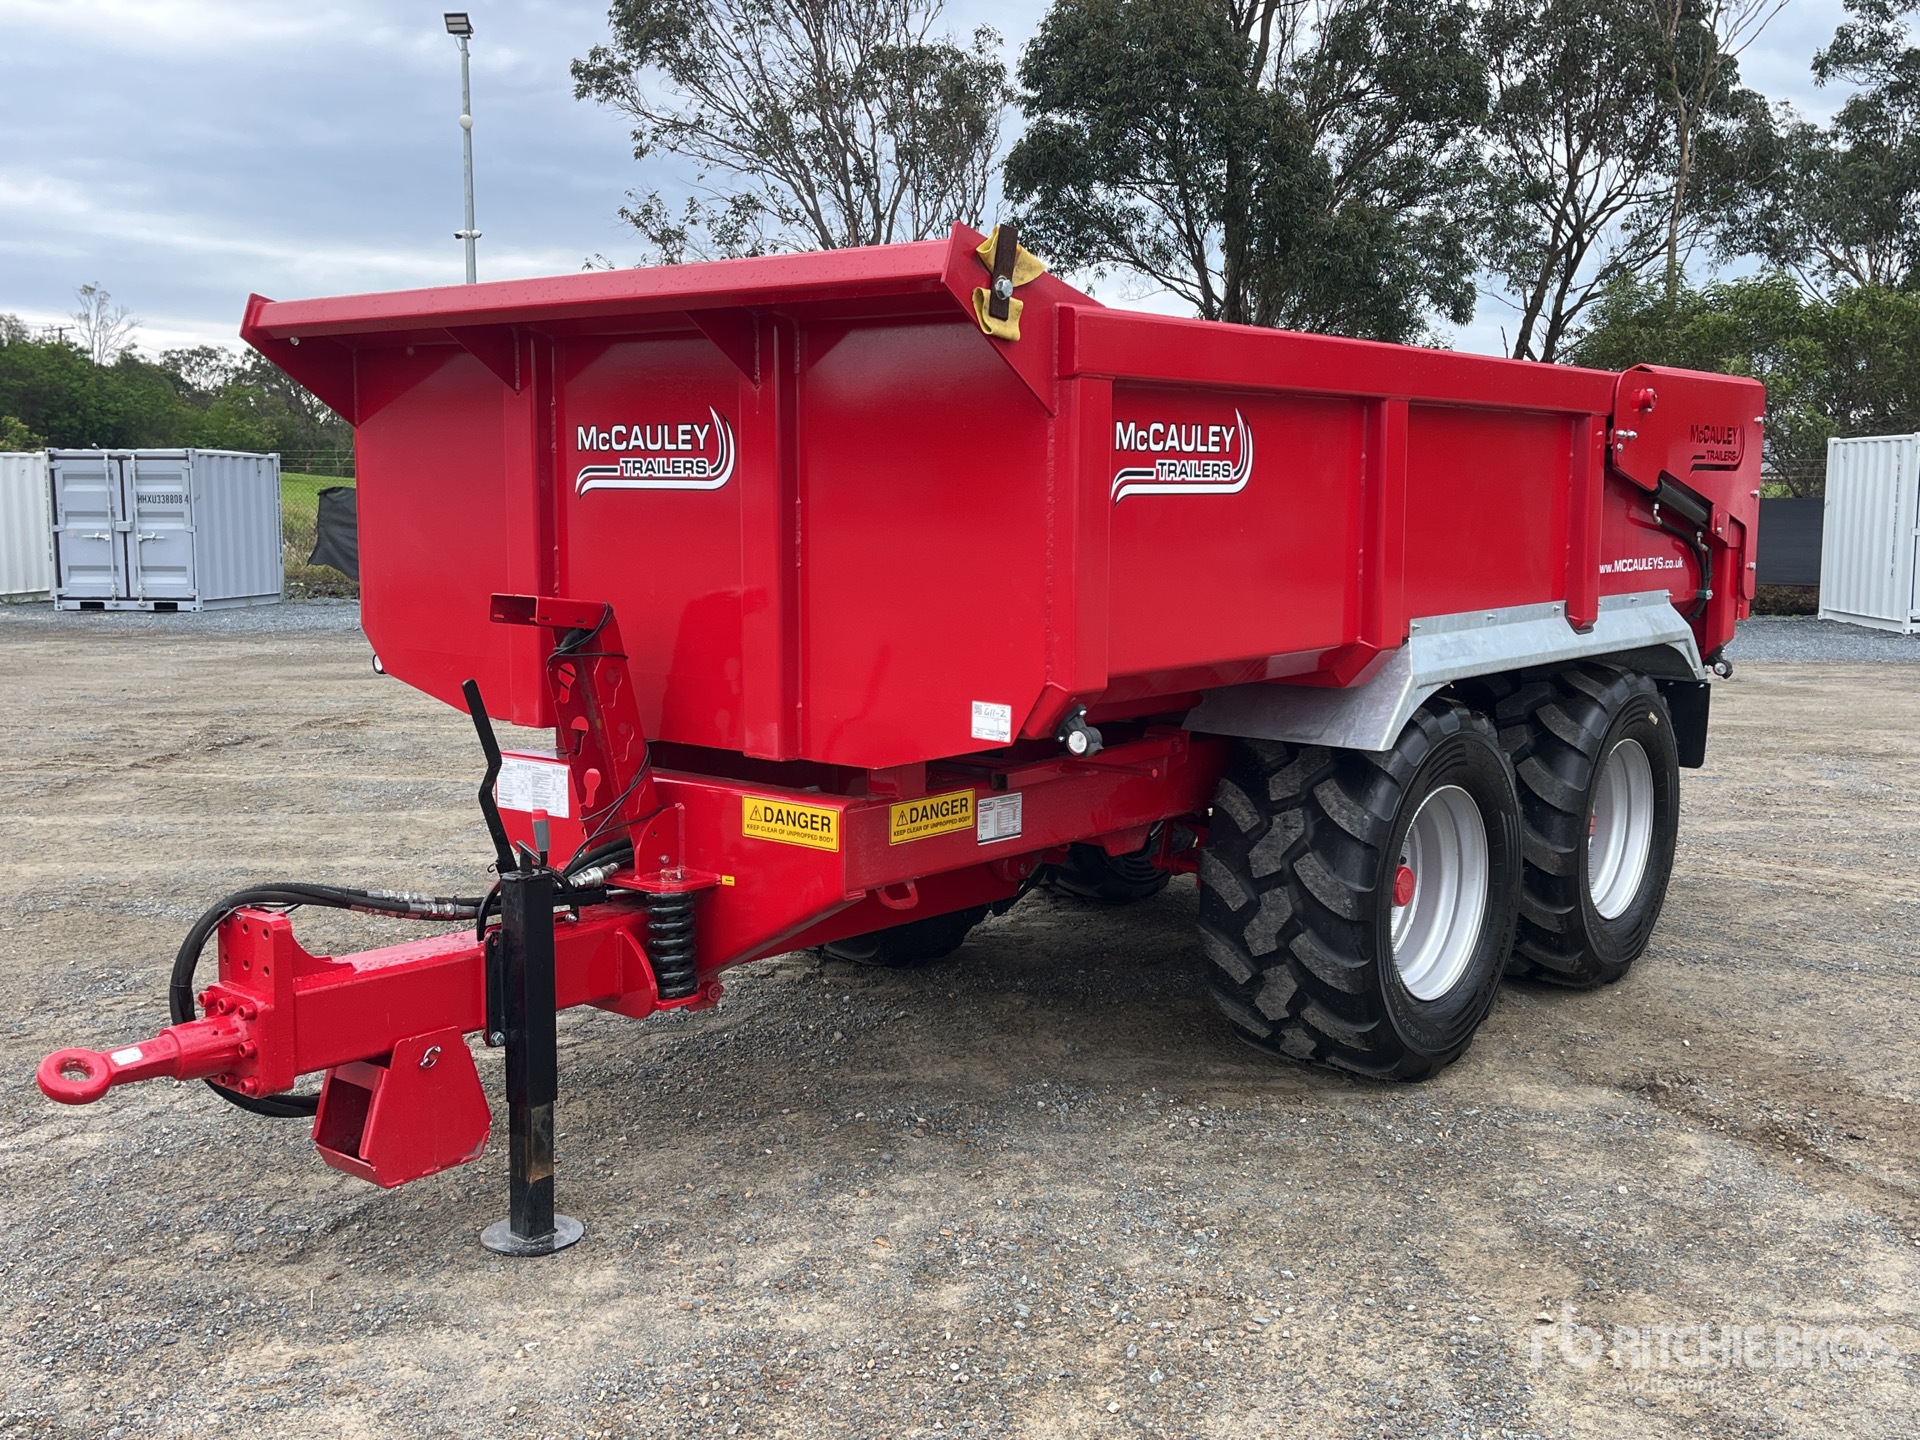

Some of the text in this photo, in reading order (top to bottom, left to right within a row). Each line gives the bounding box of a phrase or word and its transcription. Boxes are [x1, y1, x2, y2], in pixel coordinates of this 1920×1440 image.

[577, 424, 710, 451] McCAULEY
[1115, 421, 1235, 453] McCAULEY
[1690, 424, 1739, 445] McCAULEY
[1706, 450, 1737, 462] TRAILERS
[620, 458, 708, 476] TRAILERS
[1157, 461, 1232, 479] TRAILERS
[763, 805, 831, 833] DANGER
[910, 797, 969, 825] DANGER
[761, 825, 778, 834] CLEAR
[786, 830, 819, 841] UNPROPPED
[819, 835, 834, 844] BODY
[893, 829, 906, 837] KEEP
[907, 825, 922, 834] CLEAR
[958, 815, 971, 823] BODY
